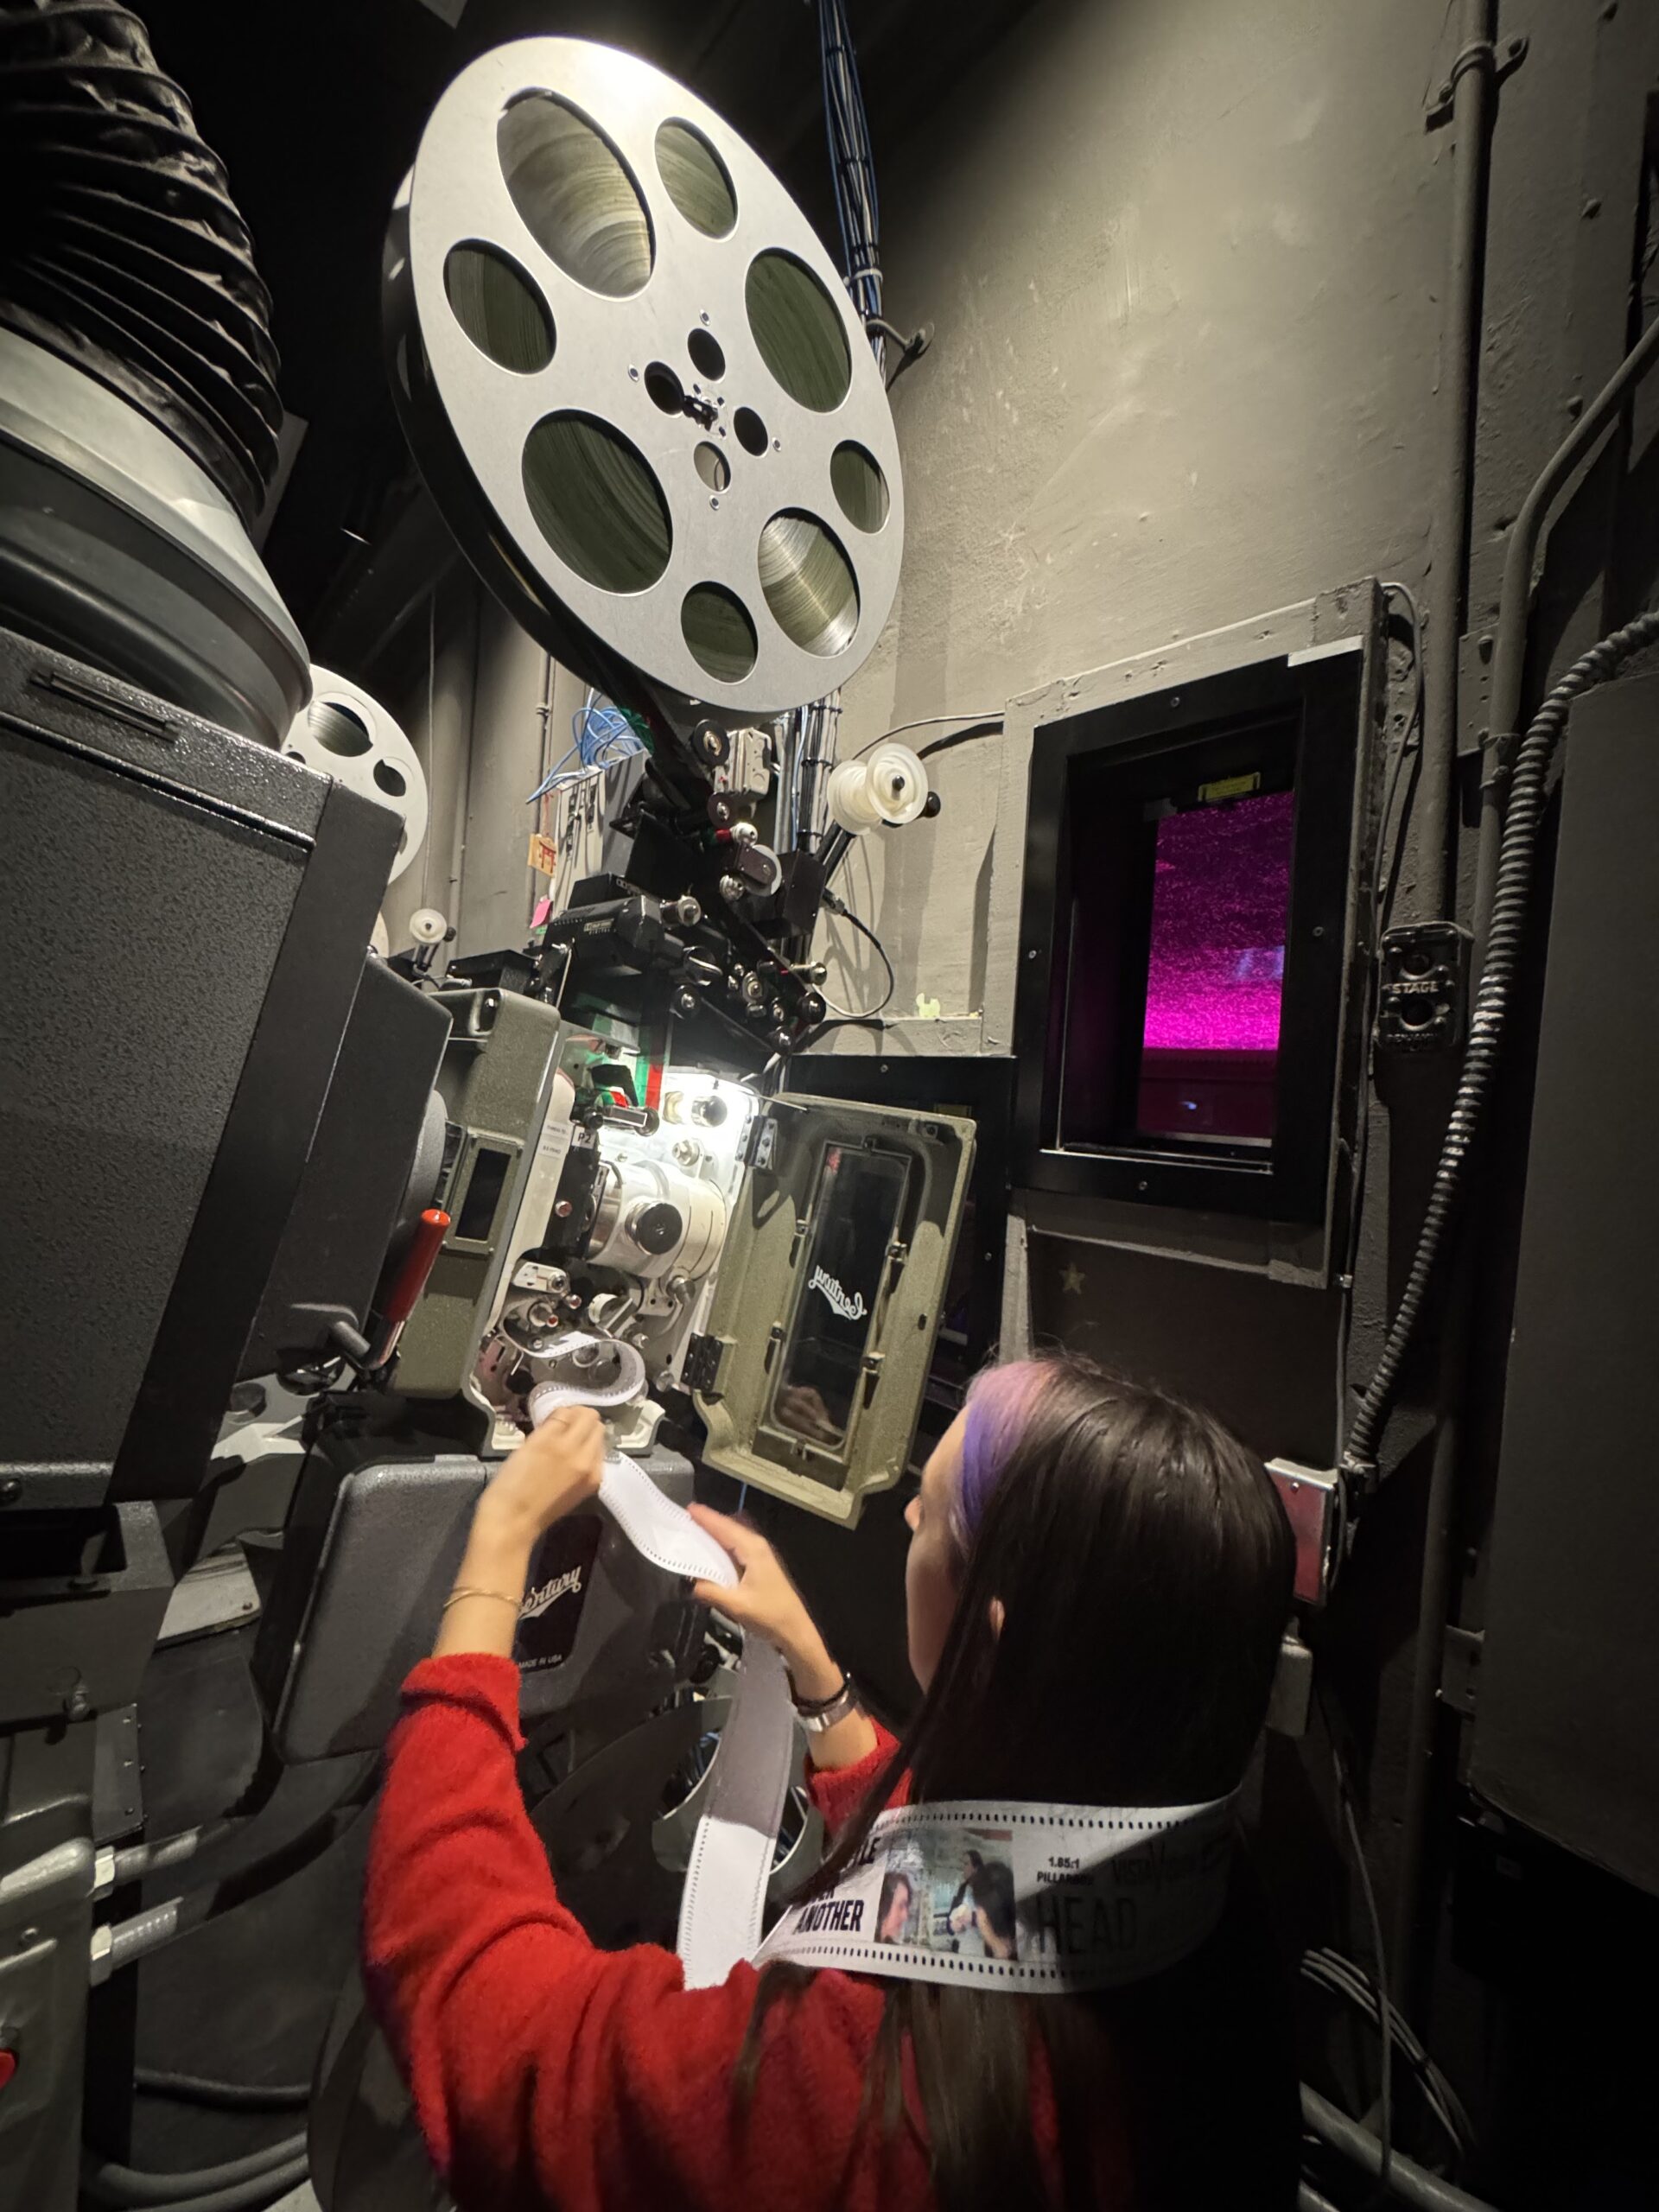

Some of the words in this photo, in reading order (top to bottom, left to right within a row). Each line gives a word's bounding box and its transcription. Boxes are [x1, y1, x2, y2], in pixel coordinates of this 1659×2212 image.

[1392, 981, 1440, 995] STAGE
[577, 1132, 592, 1144] P2
[518, 1566, 582, 1616] entury
[548, 1654, 563, 1663] USA
[792, 1900, 865, 1935] ANOTHER
[1036, 1895, 1138, 1955] HEAD
